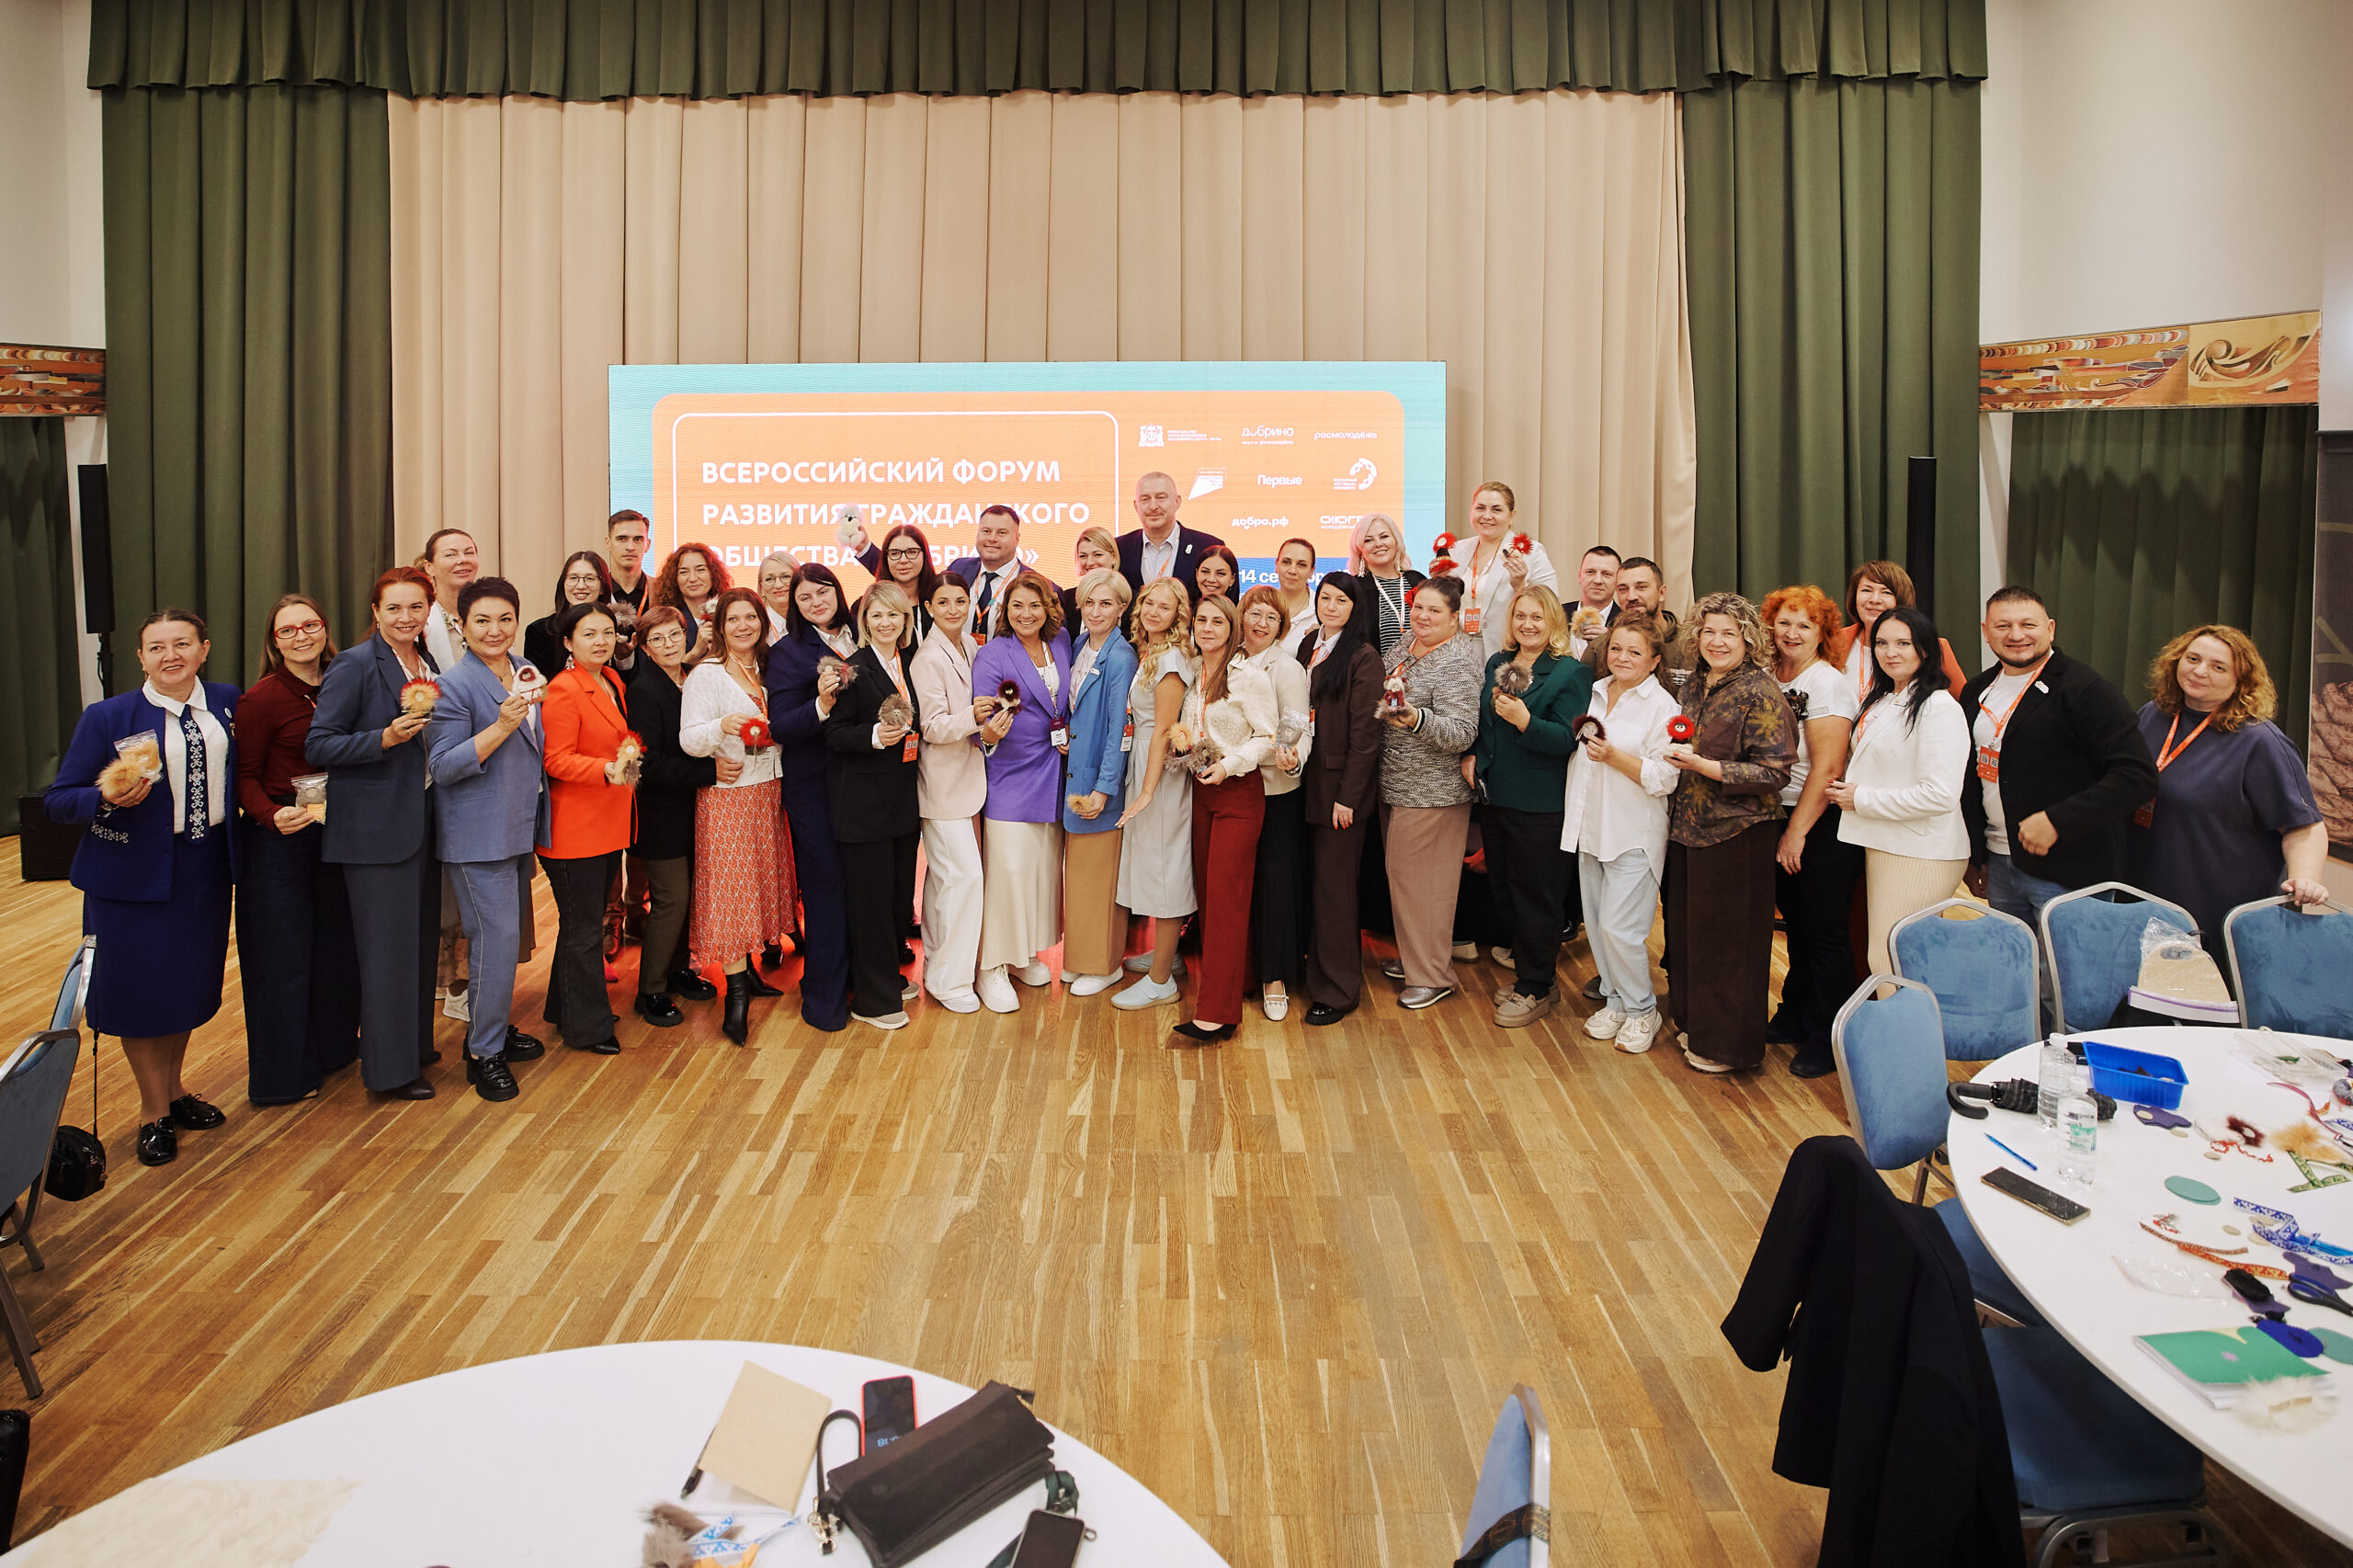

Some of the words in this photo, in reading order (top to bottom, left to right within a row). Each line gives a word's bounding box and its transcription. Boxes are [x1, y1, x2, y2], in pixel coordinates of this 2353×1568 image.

[702, 457, 944, 483] ВСЕРОССИЙСКИЙ
[952, 459, 1061, 484] ФОРУМ
[1256, 473, 1303, 489] Первые
[702, 503, 847, 526] РАЗВИТИЯ
[856, 502, 1091, 528] ГРАЖДАКОГО
[1231, 515, 1290, 529] добро.рф
[708, 544, 861, 567] БЩСТВА
